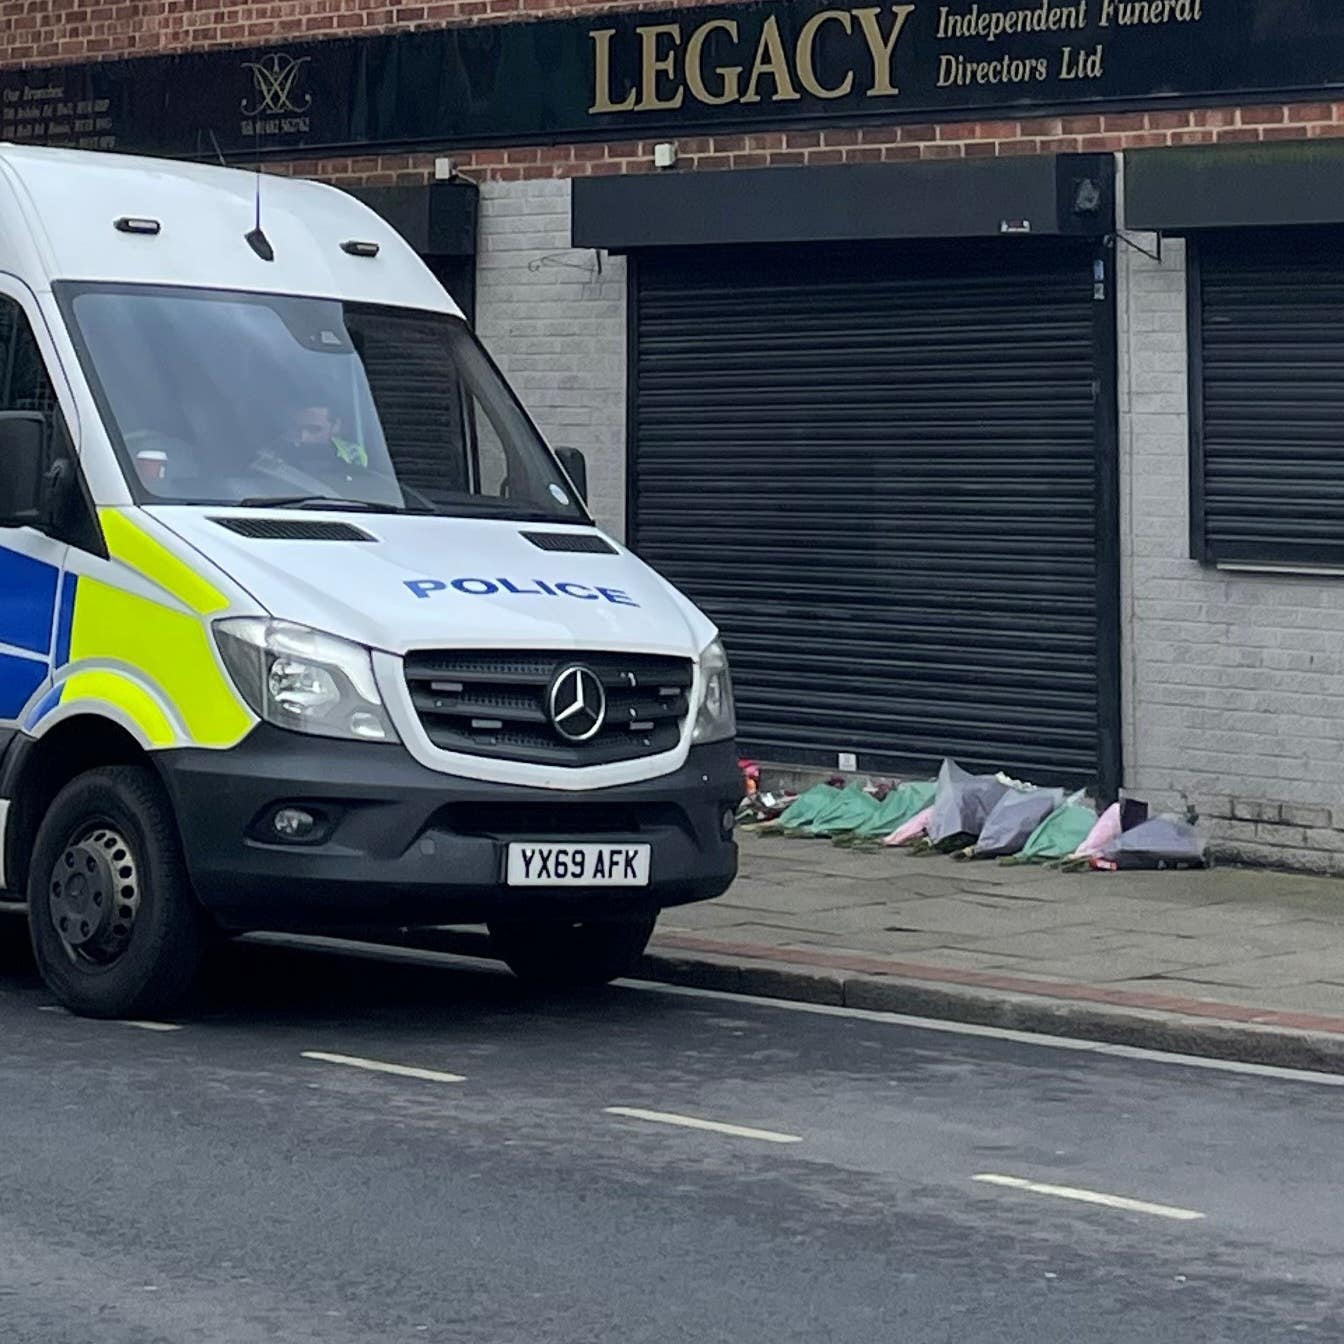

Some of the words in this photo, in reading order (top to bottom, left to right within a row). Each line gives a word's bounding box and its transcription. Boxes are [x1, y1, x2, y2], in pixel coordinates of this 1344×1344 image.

[588, 4, 915, 115] LEGACY
[937, 53, 1047, 87] Directors
[1061, 45, 1103, 80] Ltd
[402, 577, 641, 608] POLICE
[521, 848, 586, 879] YX69
[592, 848, 639, 878] AFK
